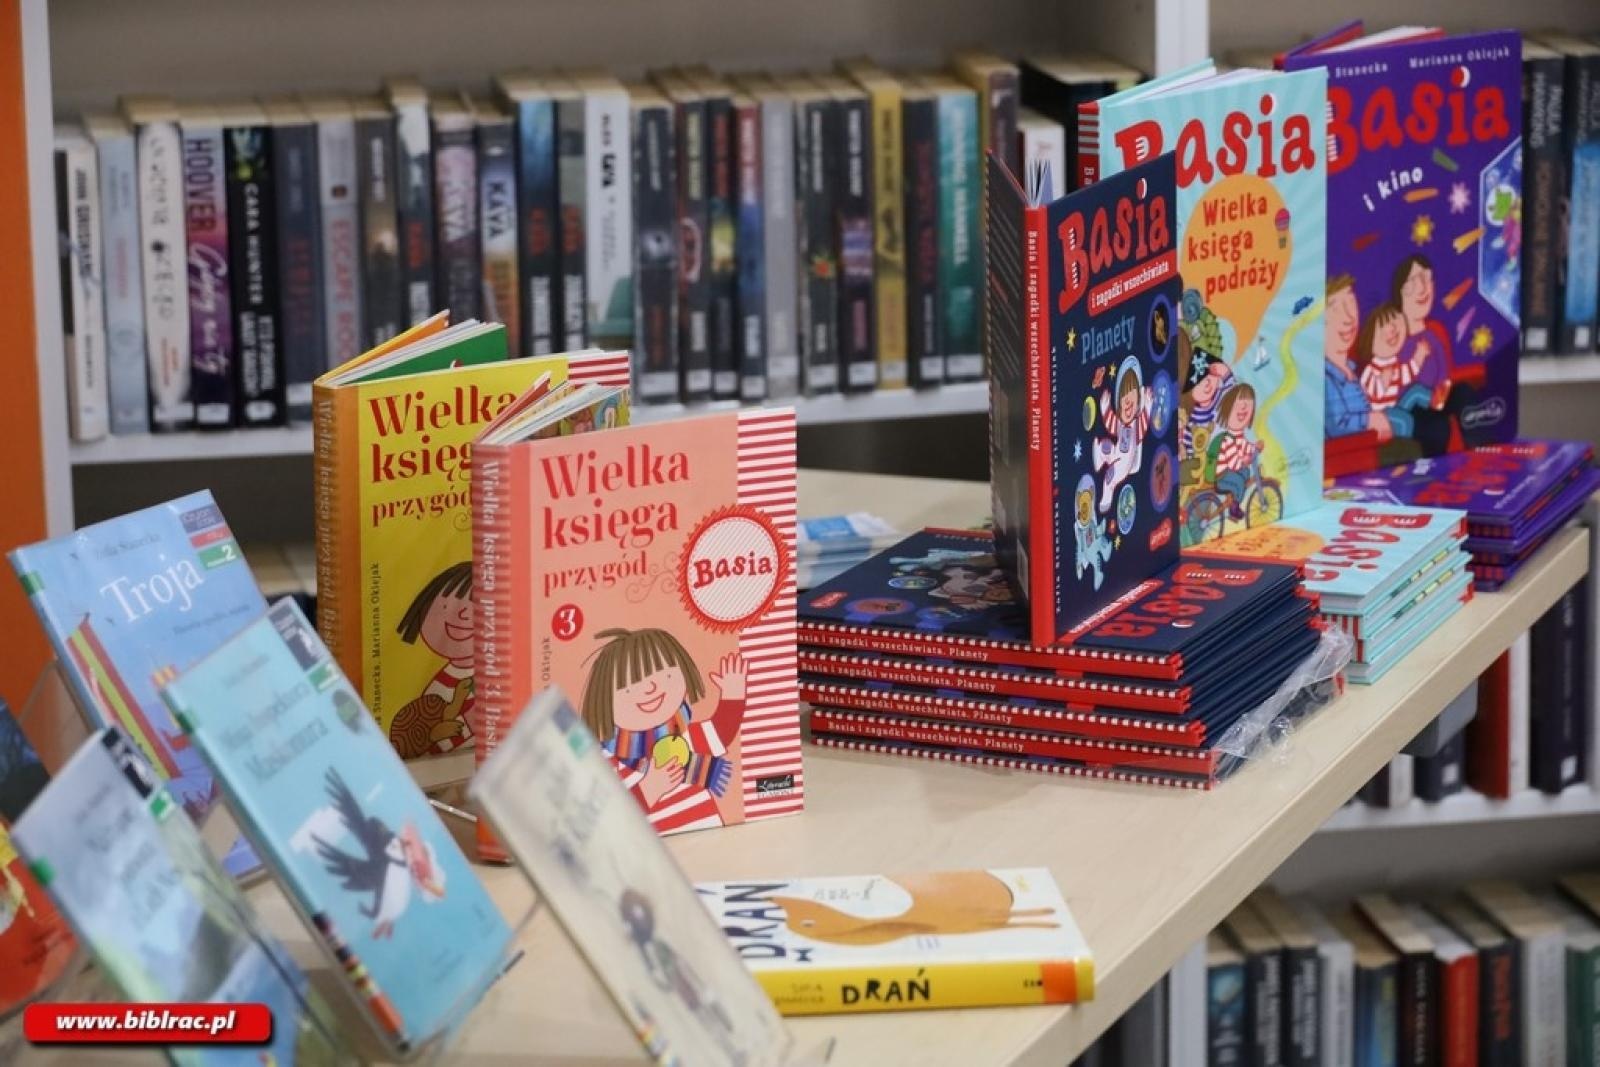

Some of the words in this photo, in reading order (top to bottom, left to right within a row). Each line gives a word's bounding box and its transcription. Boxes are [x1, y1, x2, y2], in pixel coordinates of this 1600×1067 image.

[1115, 94, 1316, 189] Basia
[186, 138, 216, 232] HOOVER
[1377, 166, 1423, 199] kino
[245, 183, 260, 230] CARA
[488, 180, 506, 241] KAVA
[1203, 192, 1267, 227] Wielka
[1028, 231, 1038, 261] Basia
[1058, 177, 1170, 314] Basia
[1188, 230, 1255, 262] księga
[246, 235, 263, 304] HUNTER
[1206, 252, 1280, 302] podróży
[1028, 273, 1041, 317] zagadki
[1090, 297, 1096, 309] i
[1096, 278, 1124, 307] zagadki
[1080, 313, 1136, 364] Planety
[368, 384, 517, 438] Wielka
[1030, 407, 1042, 451] Planety
[482, 461, 499, 525] Wielka
[542, 443, 690, 500] Wielka
[372, 485, 473, 527] przygód
[543, 500, 679, 549] księga
[221, 544, 237, 561] 2
[480, 532, 499, 590] księga
[543, 551, 648, 597] przygód
[692, 550, 773, 589] Basia
[100, 554, 205, 622] Troja
[480, 599, 500, 676] przygód
[559, 609, 576, 635] 3
[541, 637, 552, 681] Oklejak
[799, 634, 817, 643] asia
[829, 636, 868, 647] zagadki
[950, 647, 988, 661] Planety
[801, 661, 828, 672] Basia
[838, 666, 878, 677] zagadki
[957, 678, 996, 692] Planety
[818, 694, 844, 704] Basia
[854, 696, 894, 709] zagadki
[973, 710, 1012, 725] Planety
[828, 720, 855, 732] Basia
[865, 725, 904, 737] zagadki
[985, 738, 1024, 753] Planety
[842, 969, 931, 1006] DRAŃ
